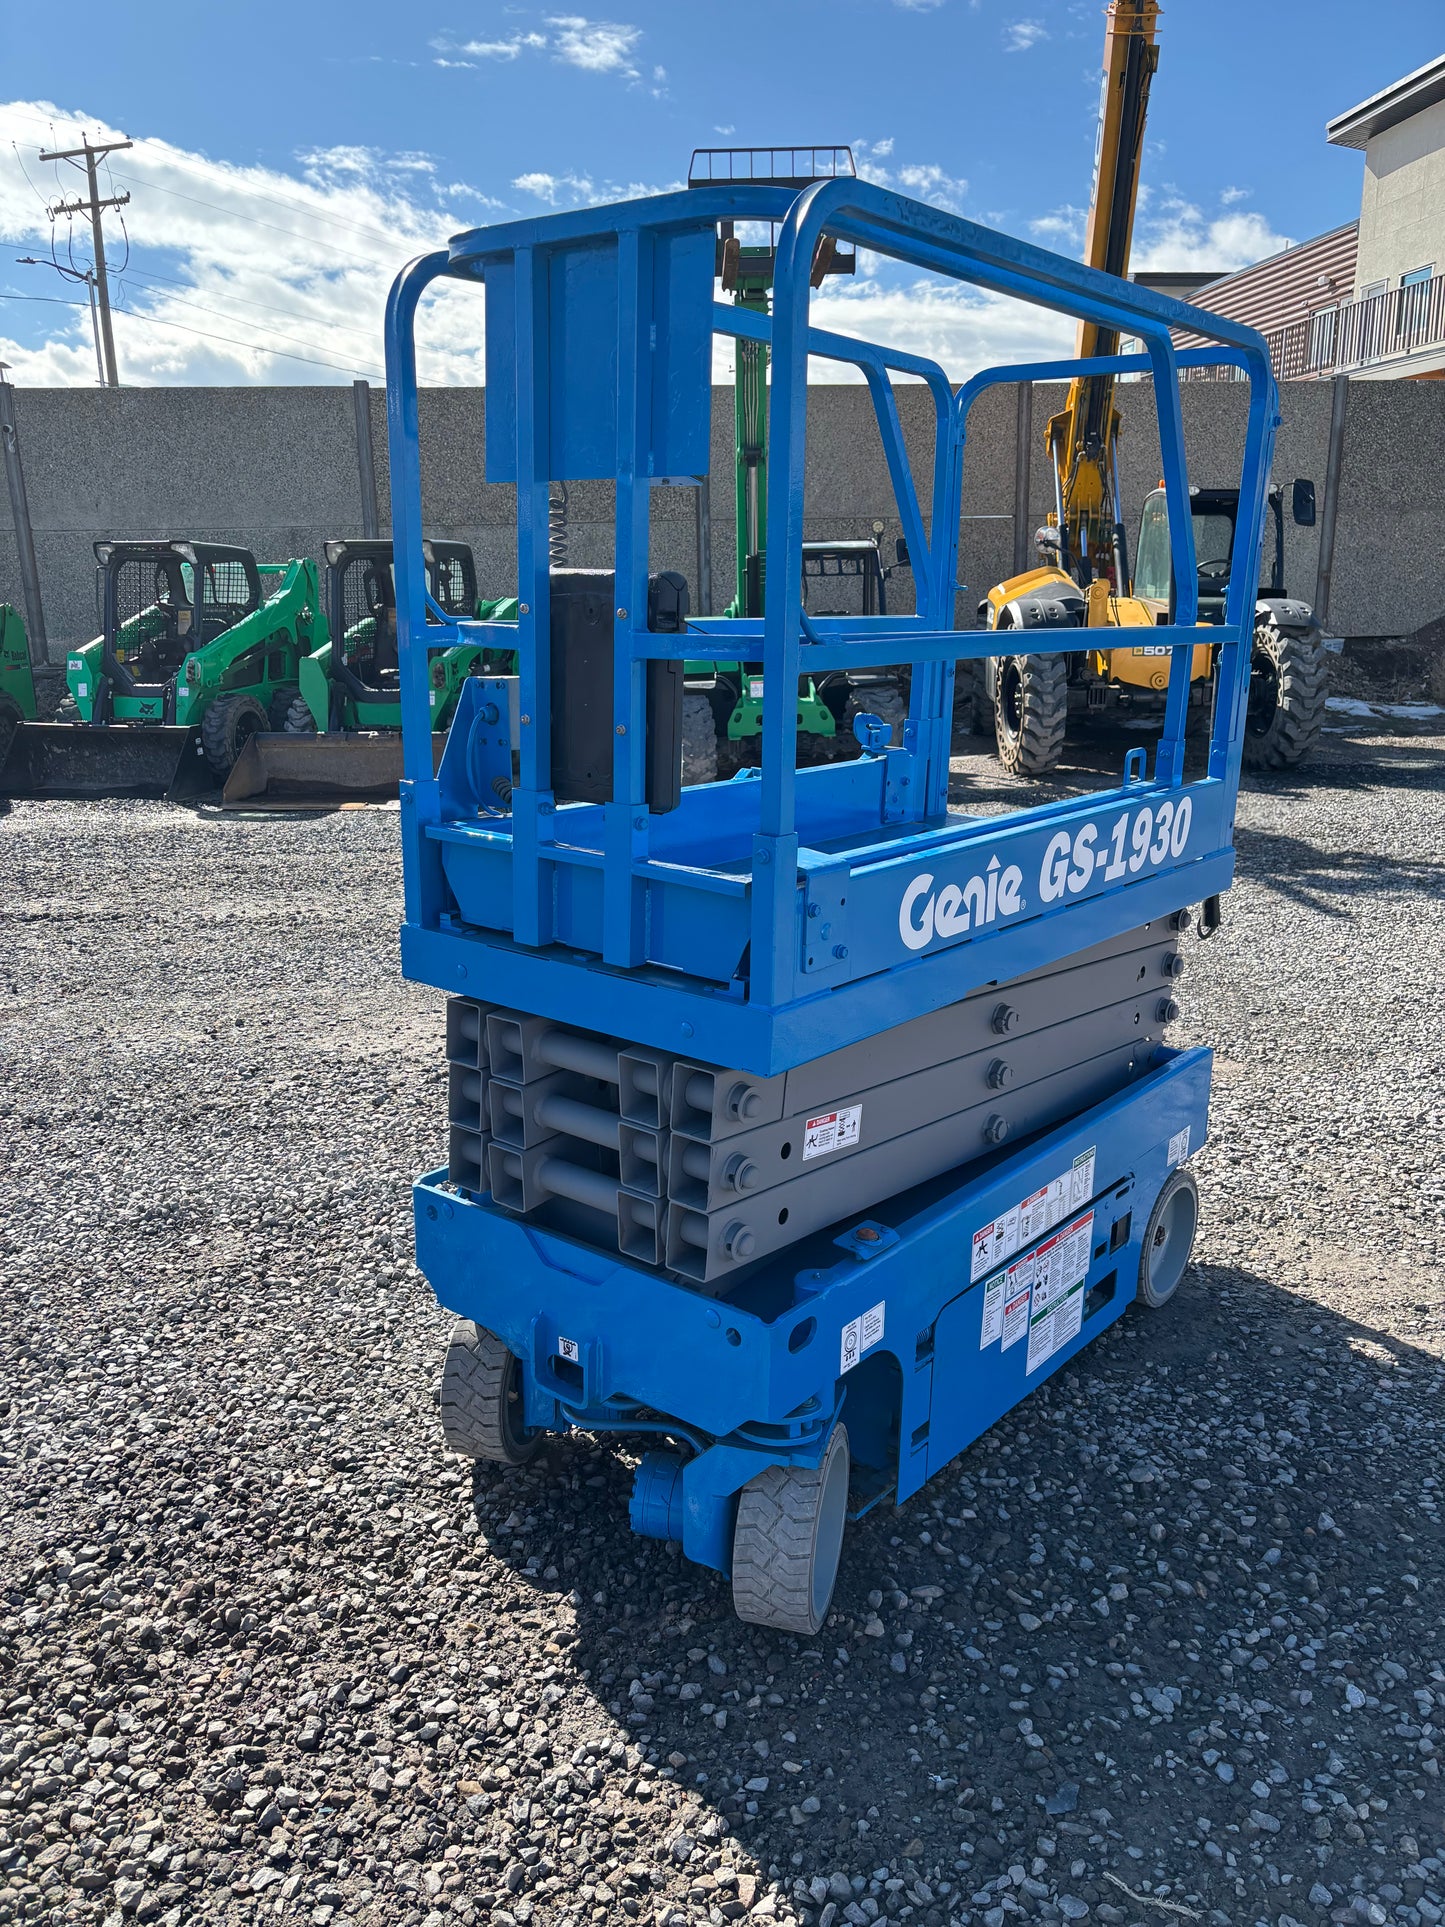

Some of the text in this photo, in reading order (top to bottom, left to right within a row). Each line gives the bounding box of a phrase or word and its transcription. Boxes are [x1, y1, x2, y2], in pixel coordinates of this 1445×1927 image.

[899, 796, 1192, 950] Genie GS-1930
[816, 1116, 831, 1126] DANGER
[979, 1225, 994, 1240] DANGER
[1059, 1226, 1074, 1240] DANGER
[988, 1276, 1004, 1290] NOTICE
[1011, 1293, 1027, 1309] DANGER
[1046, 1292, 1069, 1313] INSTRUCTIONS
